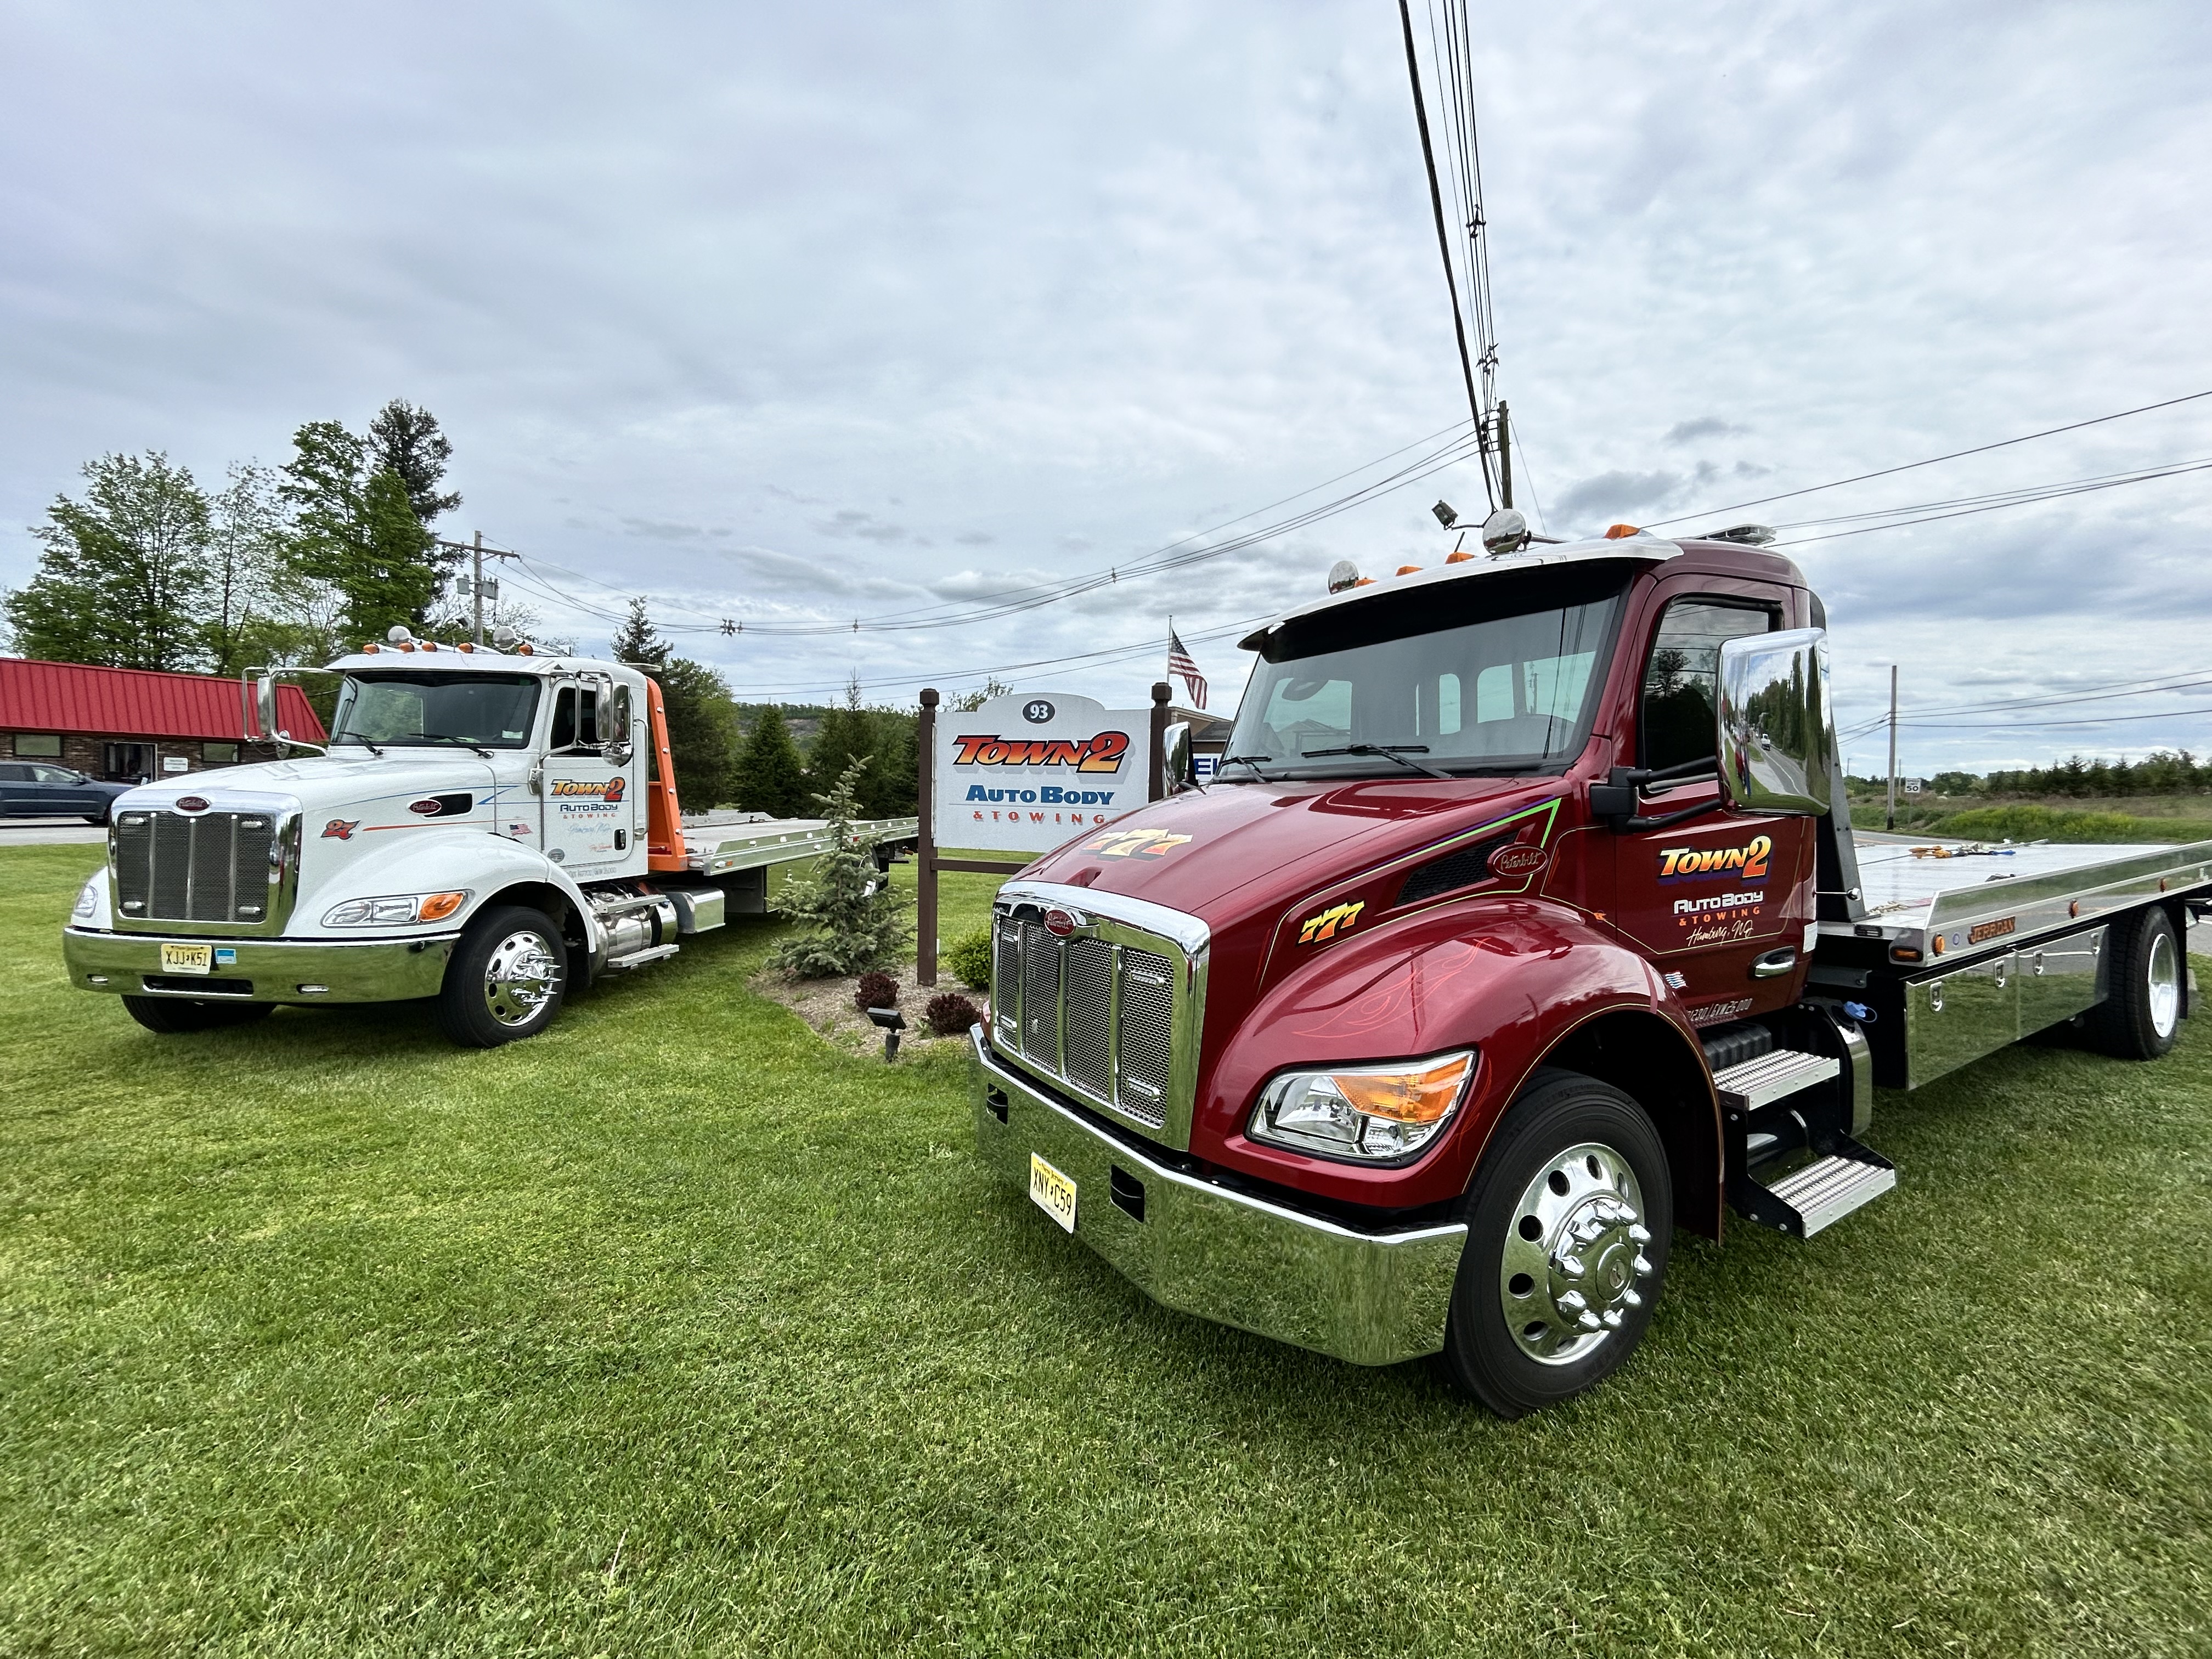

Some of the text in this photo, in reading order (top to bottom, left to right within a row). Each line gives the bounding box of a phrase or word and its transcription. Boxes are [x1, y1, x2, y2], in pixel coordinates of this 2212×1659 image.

[1029, 704, 1048, 719] 93
[966, 785, 1115, 805] AUTO BODY
[991, 811, 1104, 823] TOWING
[320, 819, 360, 840] 27
[1081, 828, 1194, 857] 777
[1500, 852, 1542, 871] Peterbilt
[1674, 890, 1764, 915] AUTO BODY
[1297, 900, 1365, 944] 777
[1691, 906, 1760, 924] TOWING
[1034, 1167, 1049, 1199] XNY
[1054, 1184, 1071, 1216] C59
